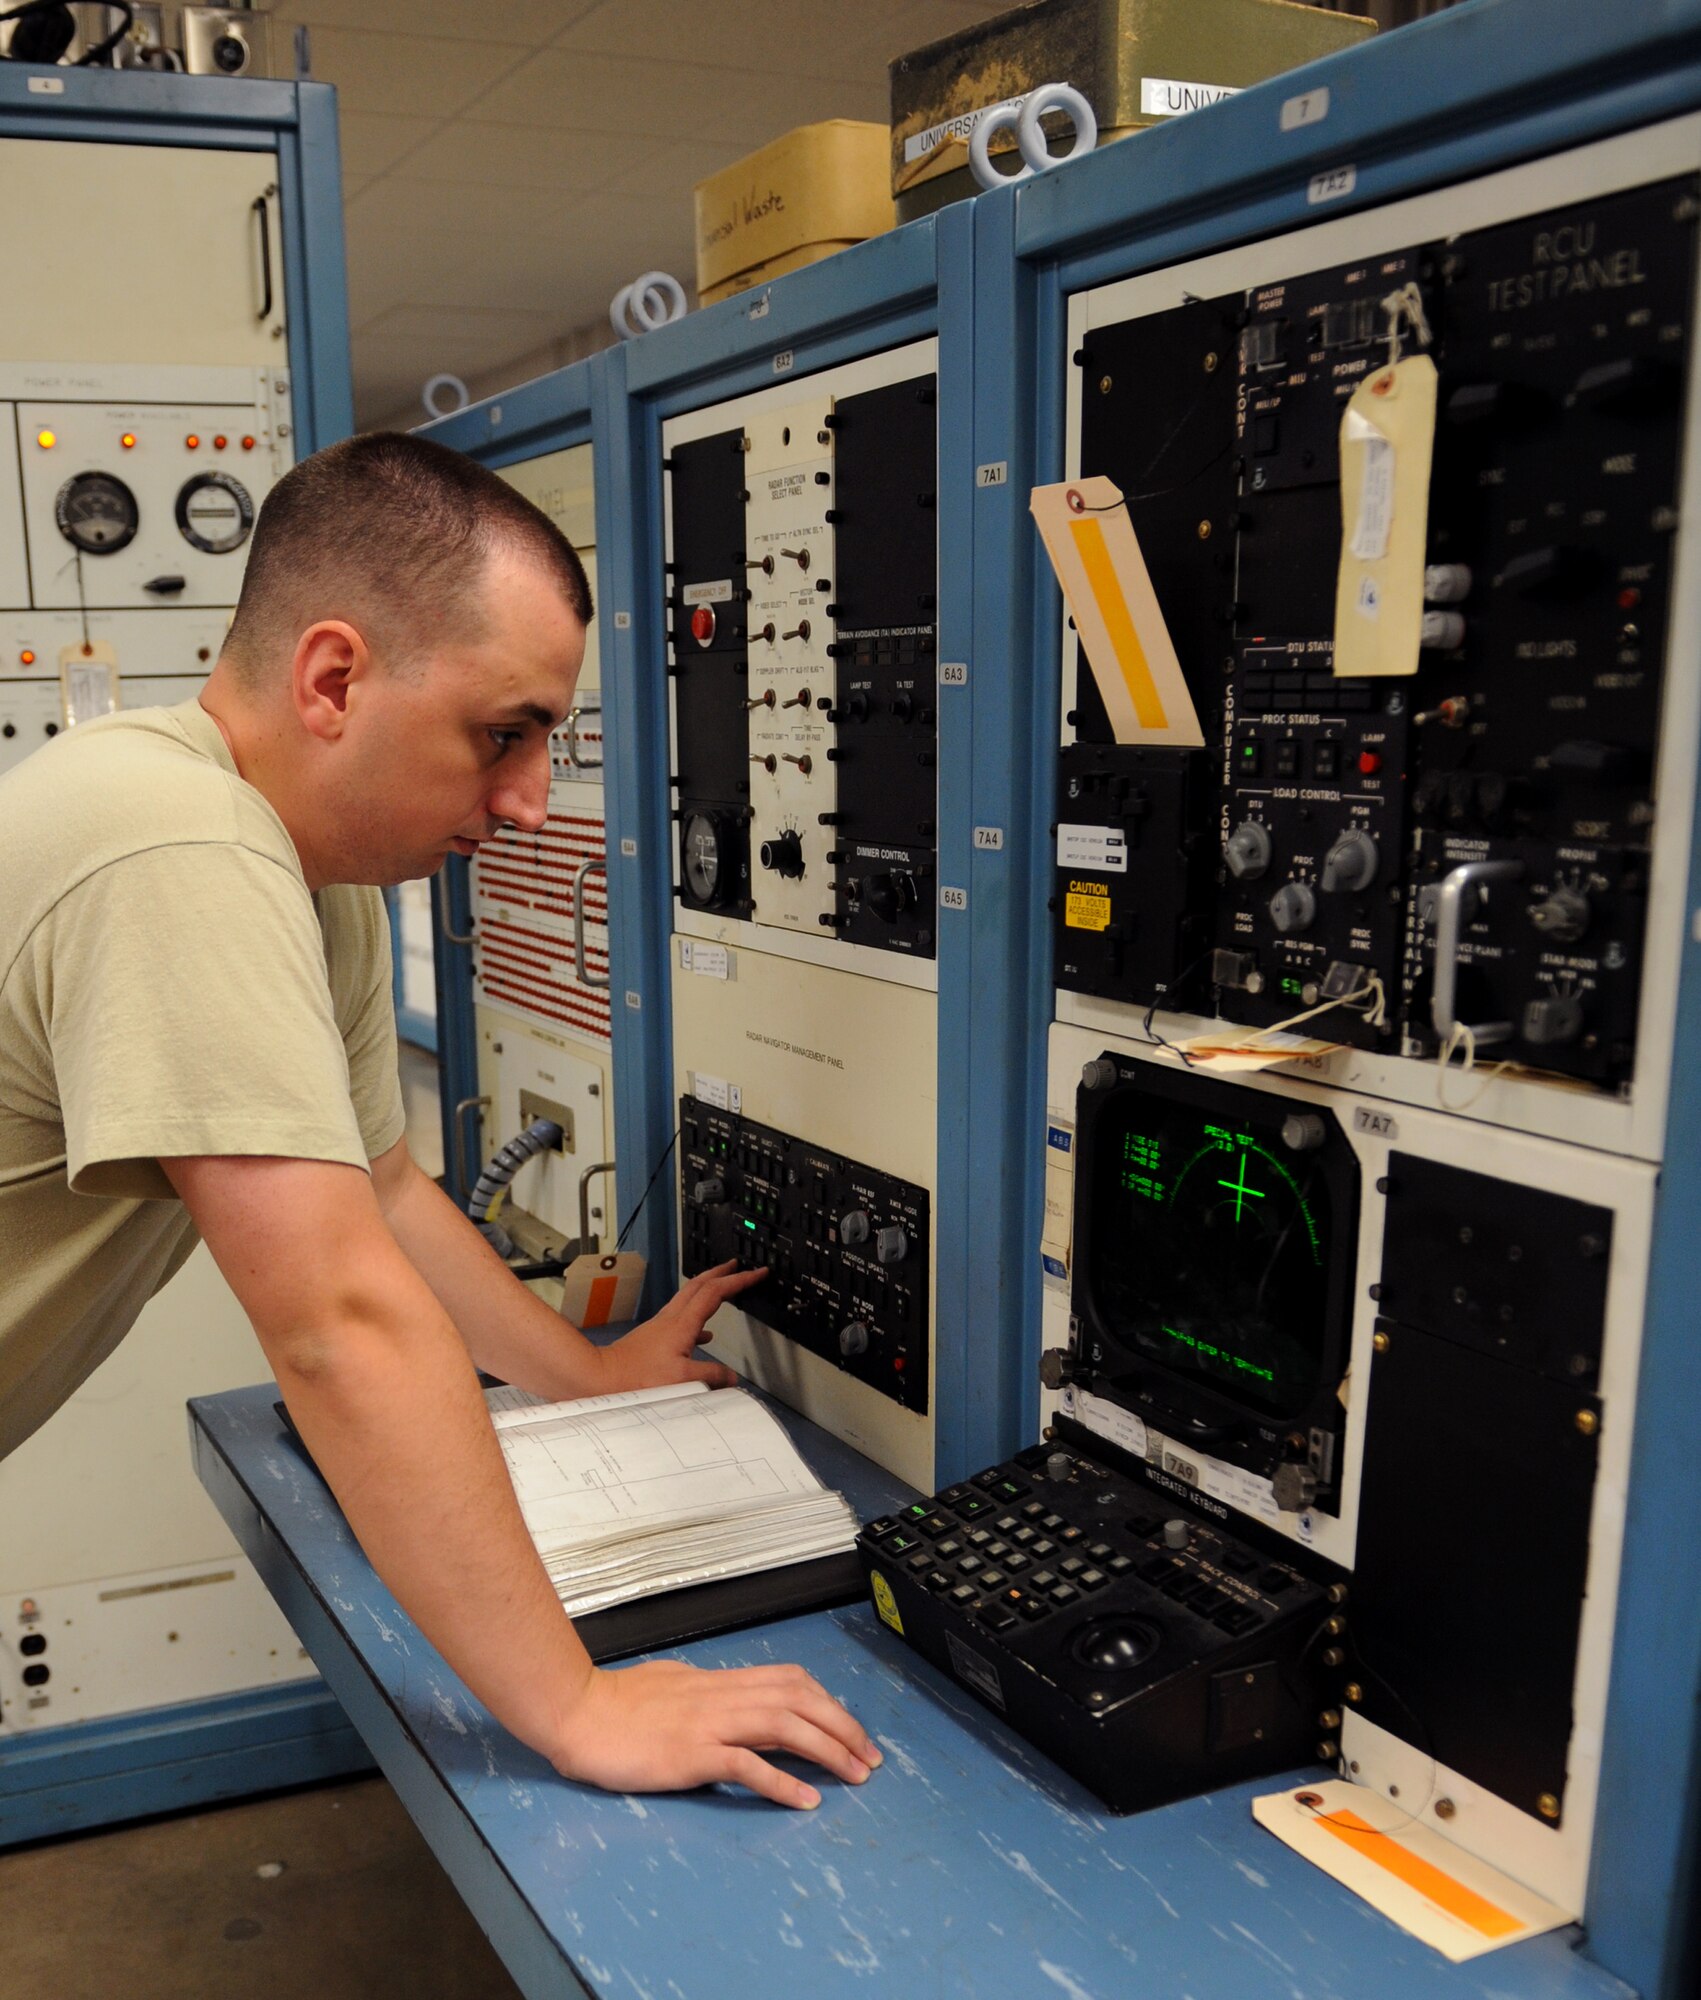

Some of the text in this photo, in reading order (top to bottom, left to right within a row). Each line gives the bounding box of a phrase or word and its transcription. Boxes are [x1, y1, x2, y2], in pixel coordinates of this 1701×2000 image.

[1167, 86, 1235, 111] UNIV
[1300, 99, 1310, 118] 7
[920, 112, 984, 151] UNIVERSA
[1317, 171, 1348, 195] 7A2
[1533, 221, 1596, 266] RCU
[1487, 250, 1646, 312] TEST PANEL
[1258, 286, 1286, 301] MASTER
[1258, 297, 1283, 312] POWER
[1332, 359, 1368, 377] POWER
[1236, 383, 1248, 438] CONT
[768, 474, 806, 490] RADAR FUNCTION
[983, 467, 1001, 483] 7A1
[771, 486, 802, 501] SELECT PANEL
[854, 629, 880, 639] AVOIDANCE
[891, 626, 917, 637] INDICATOR
[917, 625, 933, 635] PANEL
[1286, 640, 1336, 653] DTU STATU
[944, 667, 963, 681] 6A3
[850, 681, 872, 690] LAMP TEST
[896, 680, 914, 688] TA TEST
[1261, 714, 1321, 725] PROC STATUS
[1223, 683, 1235, 787] COMPUTER
[1325, 729, 1333, 738] C
[1360, 733, 1386, 743] LAMP
[1361, 779, 1381, 789] TEST
[1272, 787, 1342, 801] LOAD CONTROL
[1247, 799, 1264, 809] DTU
[978, 831, 998, 846] 7A4
[1444, 838, 1491, 851] INDICATOR
[856, 846, 910, 862] DIMMER CONTROL
[1292, 855, 1315, 866] PROC
[1444, 849, 1488, 861] INTENSITY
[1069, 880, 1109, 896] CAUTION
[944, 890, 963, 906] 6A5
[1086, 897, 1107, 909] VOLTS
[1069, 905, 1108, 919] ACCESSIBLE
[1234, 912, 1254, 922] PROC
[1077, 916, 1099, 928] INSIDE
[1234, 922, 1254, 933] LOAD
[1350, 928, 1373, 939] PROC
[1402, 883, 1418, 993] TERRAIN
[1350, 938, 1371, 951] SYNC
[746, 1030, 845, 1070] RADAR NAVIGATOR MANAGEMENT PANEL
[1360, 1112, 1392, 1133] 7A7
[1169, 1457, 1194, 1480] 7A9
[1145, 1467, 1188, 1498] INTEGRATED
[1190, 1491, 1228, 1520] KEYBOARD
